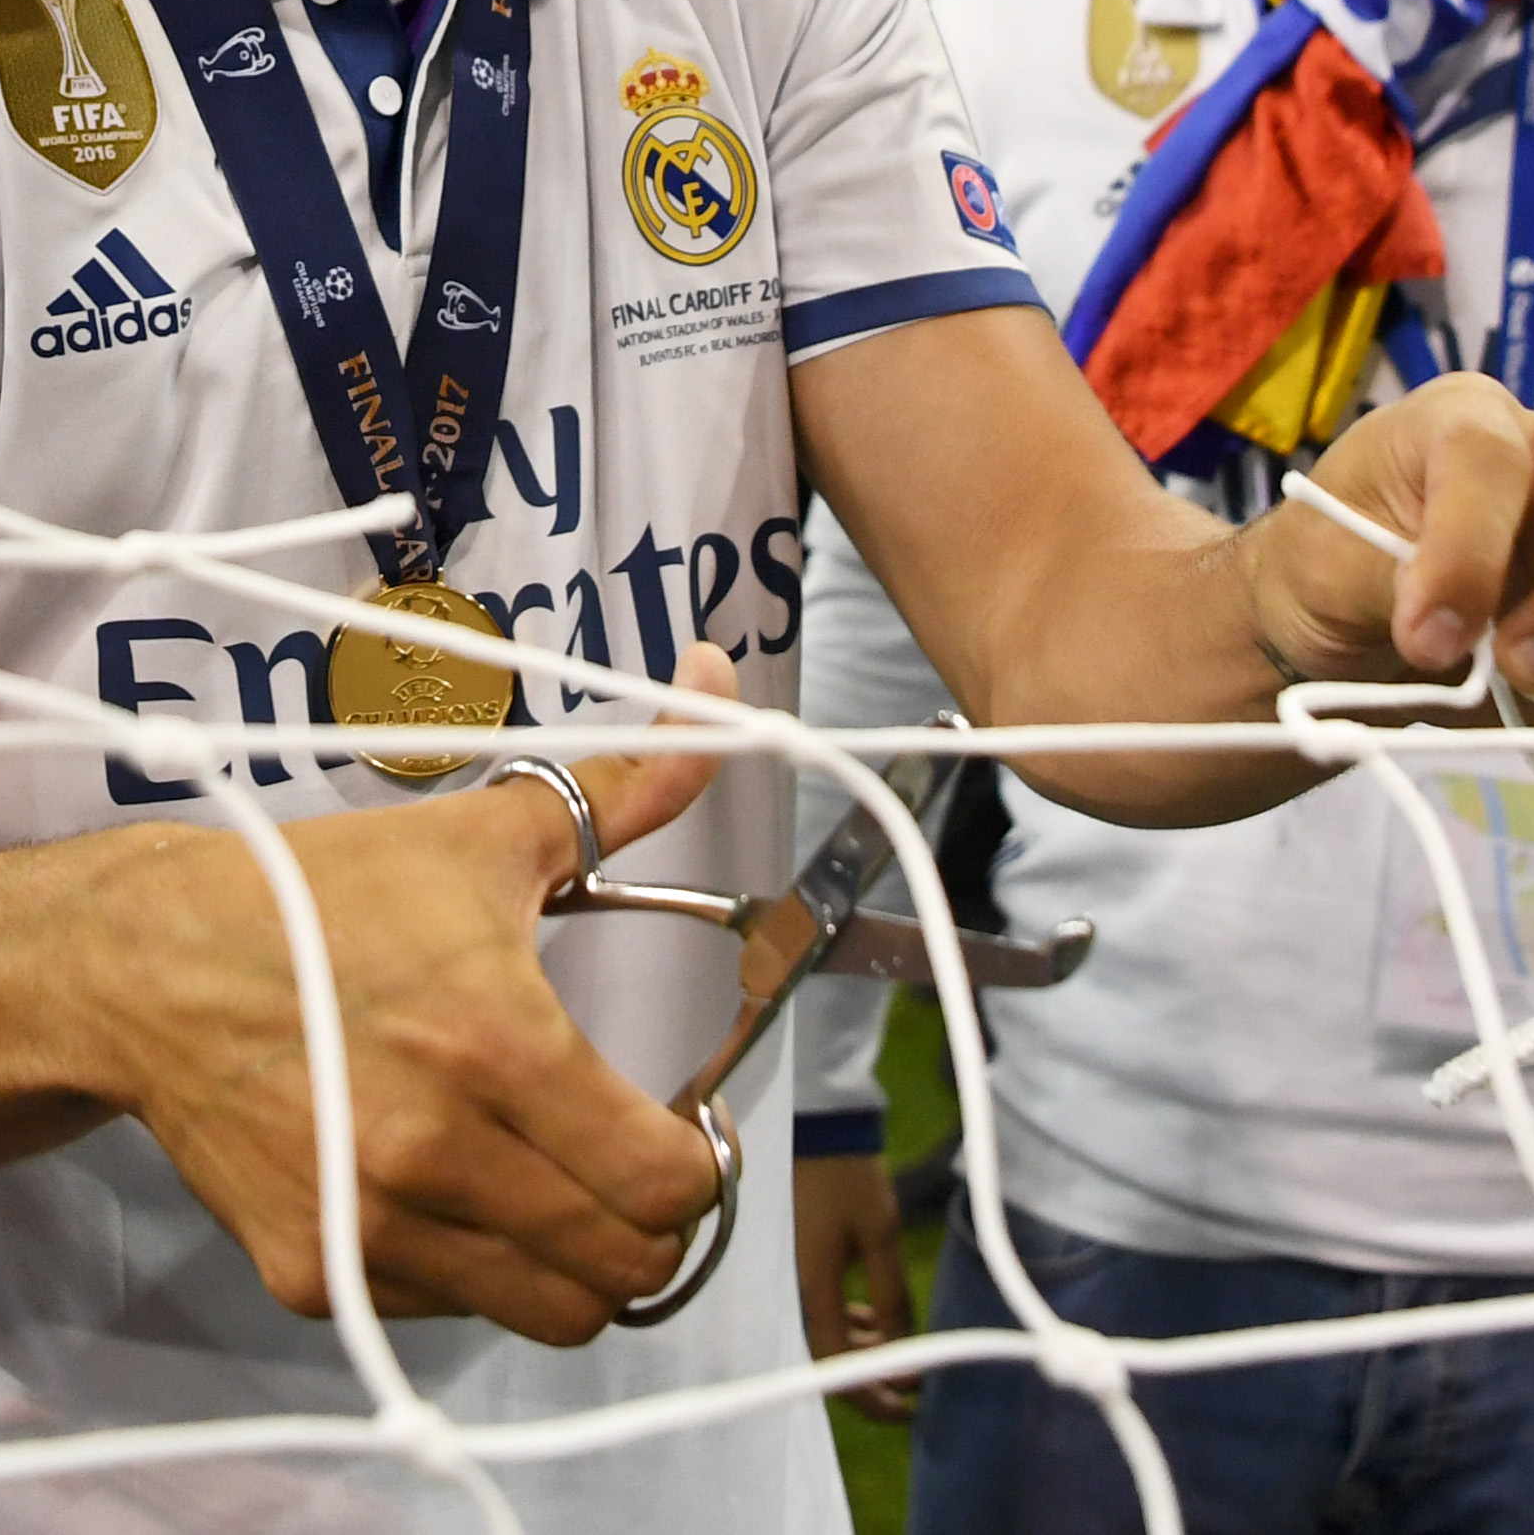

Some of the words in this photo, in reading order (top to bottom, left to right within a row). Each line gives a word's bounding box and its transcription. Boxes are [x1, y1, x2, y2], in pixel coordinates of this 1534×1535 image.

[38, 133, 79, 148] WORLD
[52, 103, 126, 133] FIFA
[73, 145, 117, 163] 2016
[292, 278, 313, 320] LEAGUE
[295, 261, 326, 328] CHAMPIONS
[611, 296, 667, 330] FINAL
[669, 281, 753, 316] CARDIFF
[758, 277, 783, 303] 20
[31, 297, 193, 359] adidas
[617, 331, 667, 350] NATIONAL
[666, 322, 710, 339] STADIUM
[710, 317, 725, 330] OF
[725, 310, 765, 327] WALES
[337, 350, 405, 492] FINAL
[422, 373, 469, 473] 2017
[97, 518, 802, 806] Emrates
